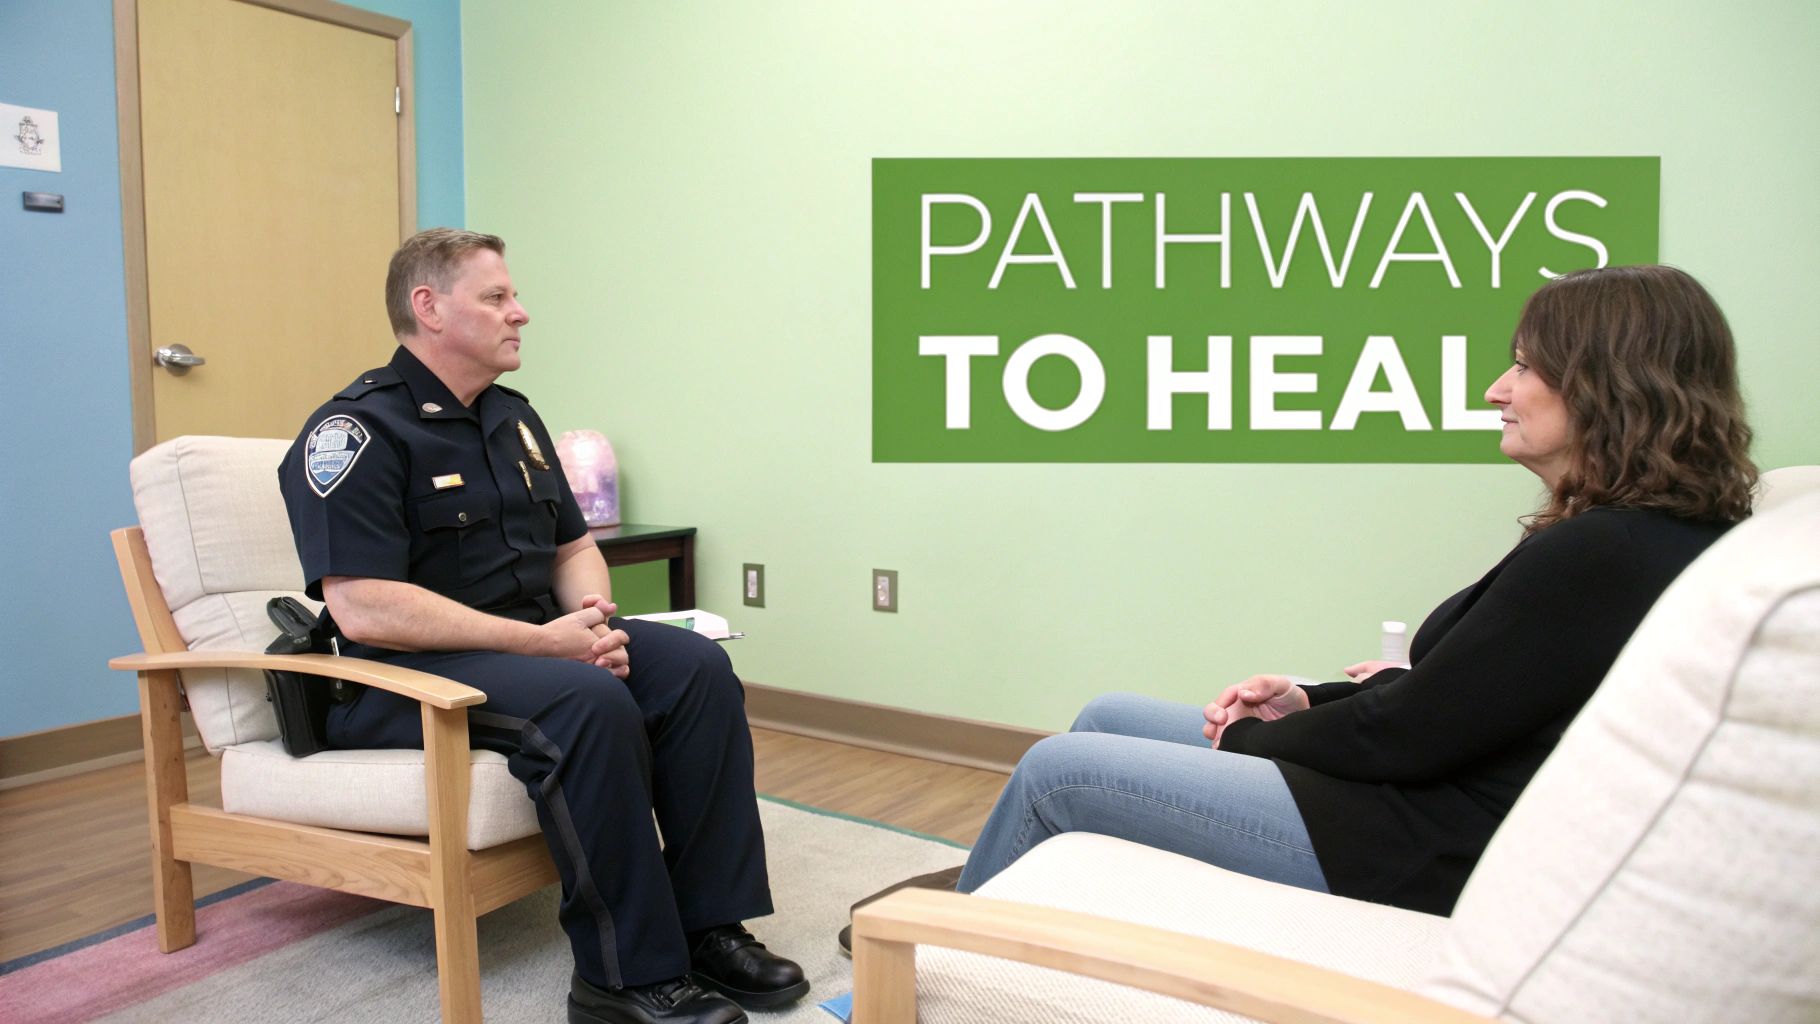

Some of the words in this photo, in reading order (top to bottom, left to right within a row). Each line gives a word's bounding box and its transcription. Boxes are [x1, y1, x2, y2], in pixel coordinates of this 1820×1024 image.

[920, 189, 1609, 290] PATHWAYS
[918, 333, 1107, 432] TO
[1146, 335, 1508, 431] HEAL
